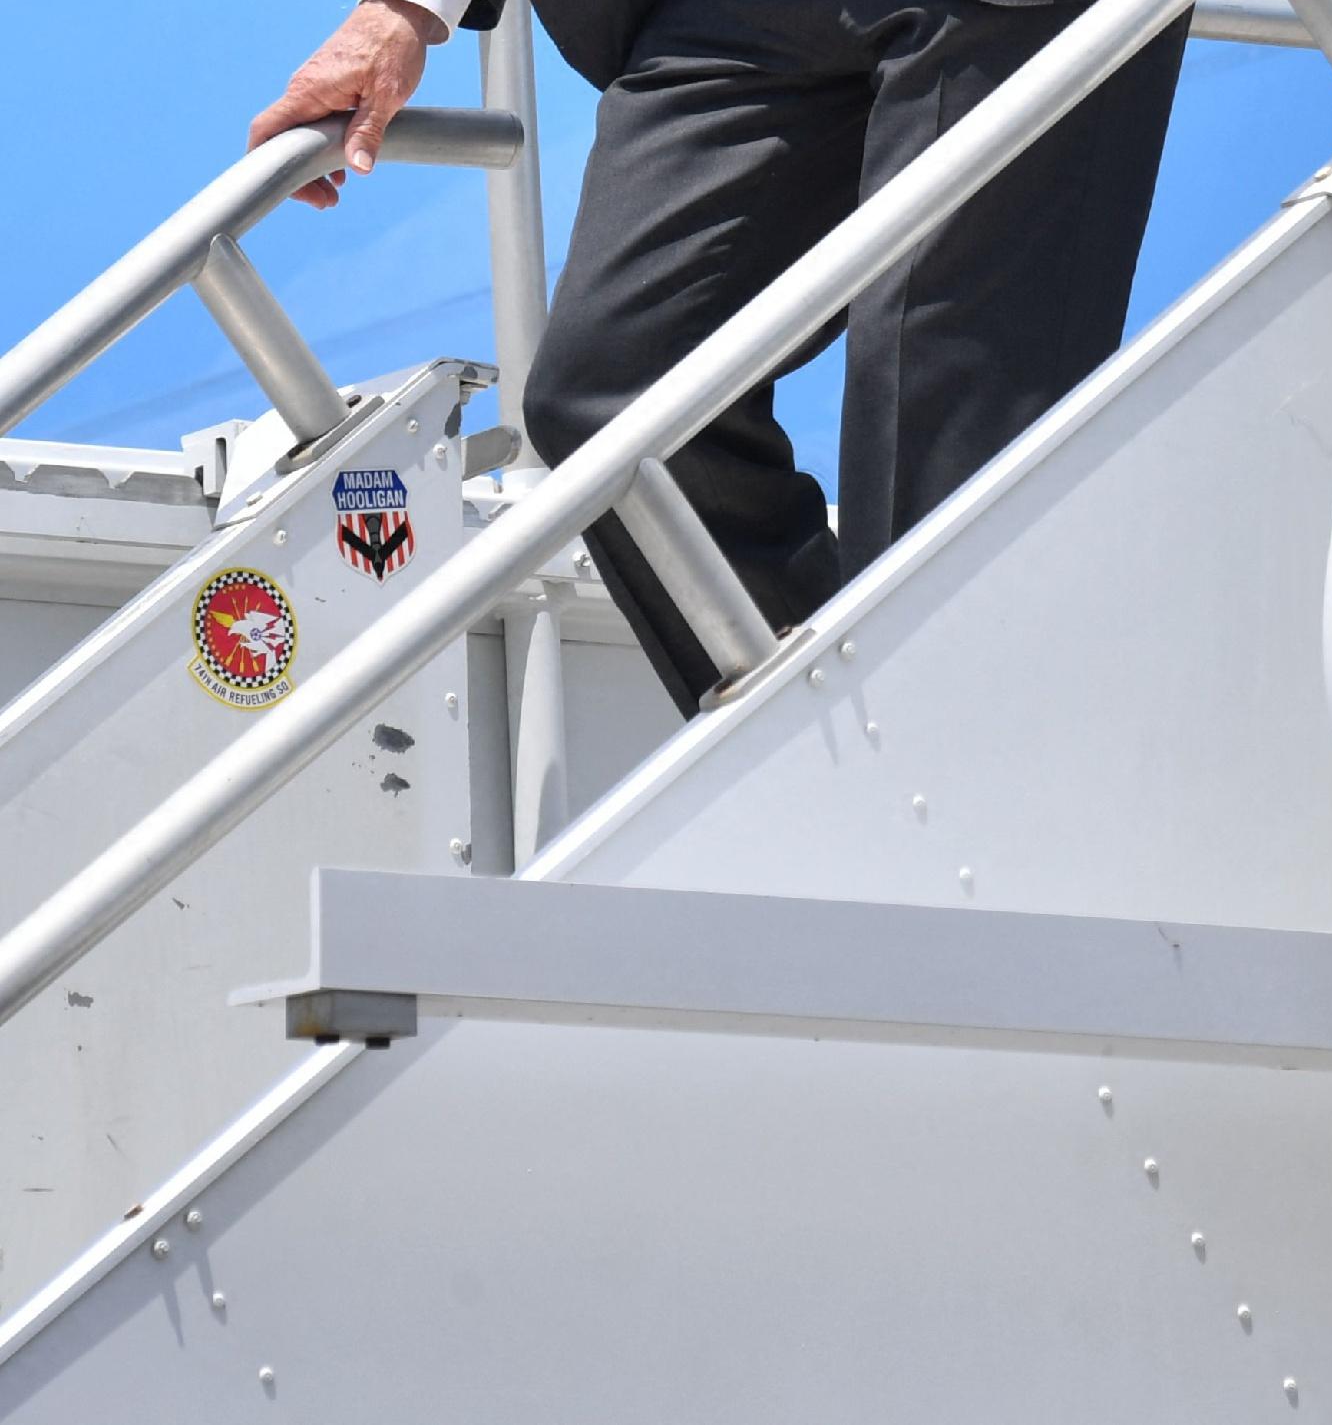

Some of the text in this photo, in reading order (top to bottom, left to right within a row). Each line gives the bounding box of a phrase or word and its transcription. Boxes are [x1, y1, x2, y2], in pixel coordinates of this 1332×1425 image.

[343, 472, 394, 490] MADAM
[337, 490, 404, 509] HOOLIGAN
[212, 681, 227, 695] AIR
[229, 688, 276, 705] REFUELING
[277, 681, 289, 694] SQ
